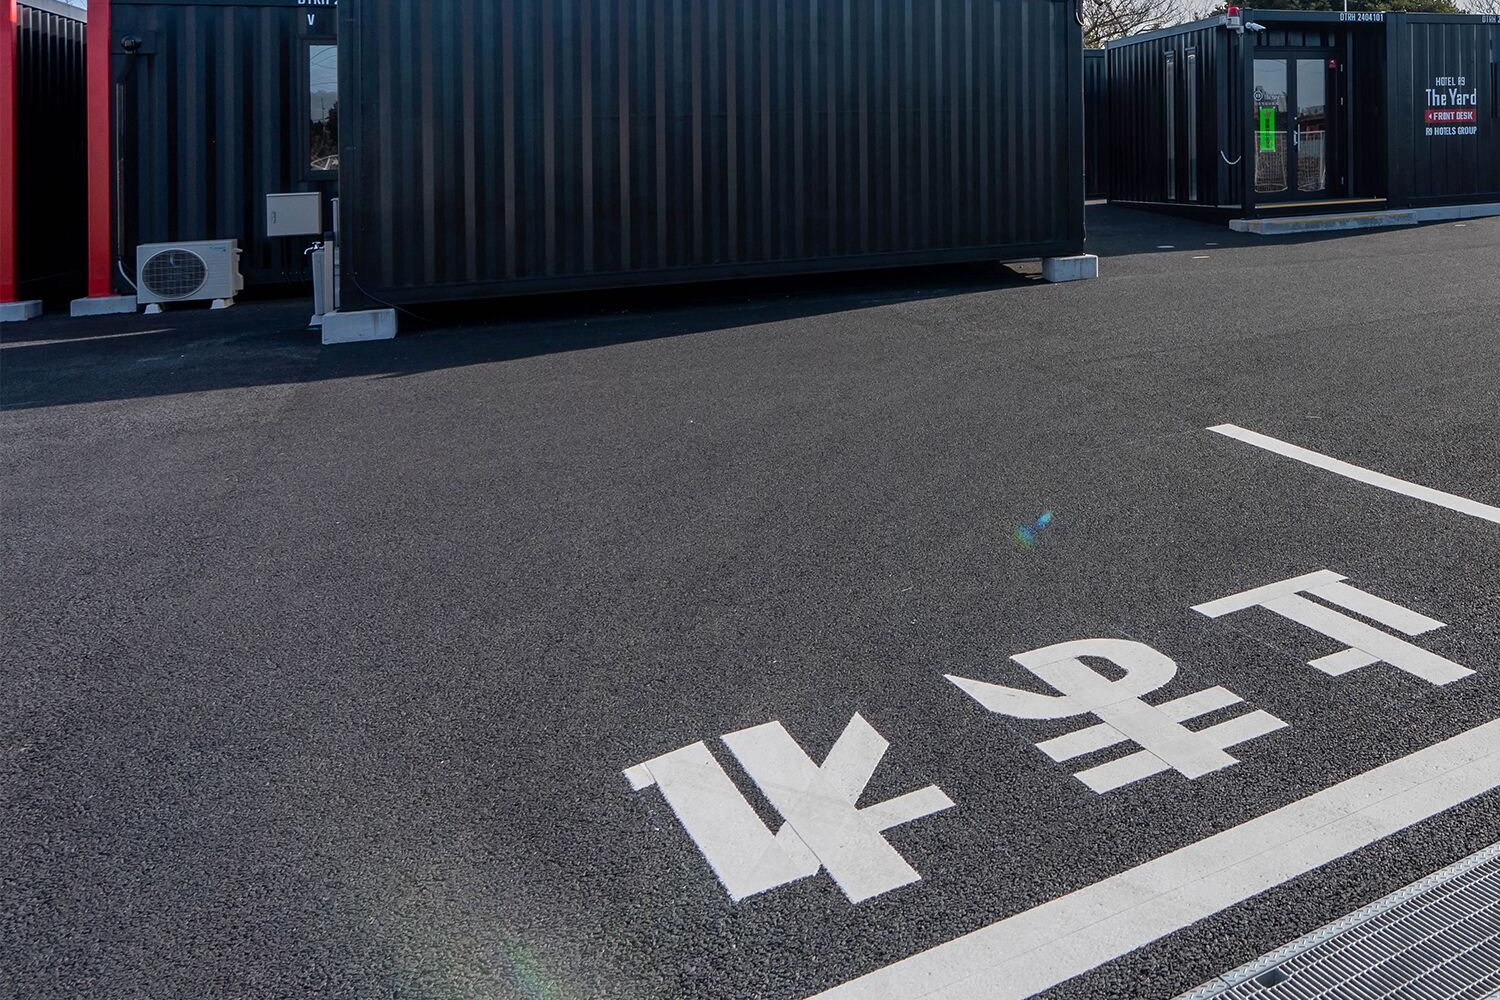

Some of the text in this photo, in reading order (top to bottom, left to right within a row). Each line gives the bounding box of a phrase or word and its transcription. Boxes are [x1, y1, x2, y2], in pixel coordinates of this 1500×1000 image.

[1357, 13, 1384, 22] 2404101
[1435, 77, 1456, 86] HOTEL
[1425, 88, 1477, 107] The Yard
[1433, 111, 1473, 120] FRONT DESK
[1434, 126, 1456, 136] HOTELS
[1457, 126, 1477, 135] GROUP
